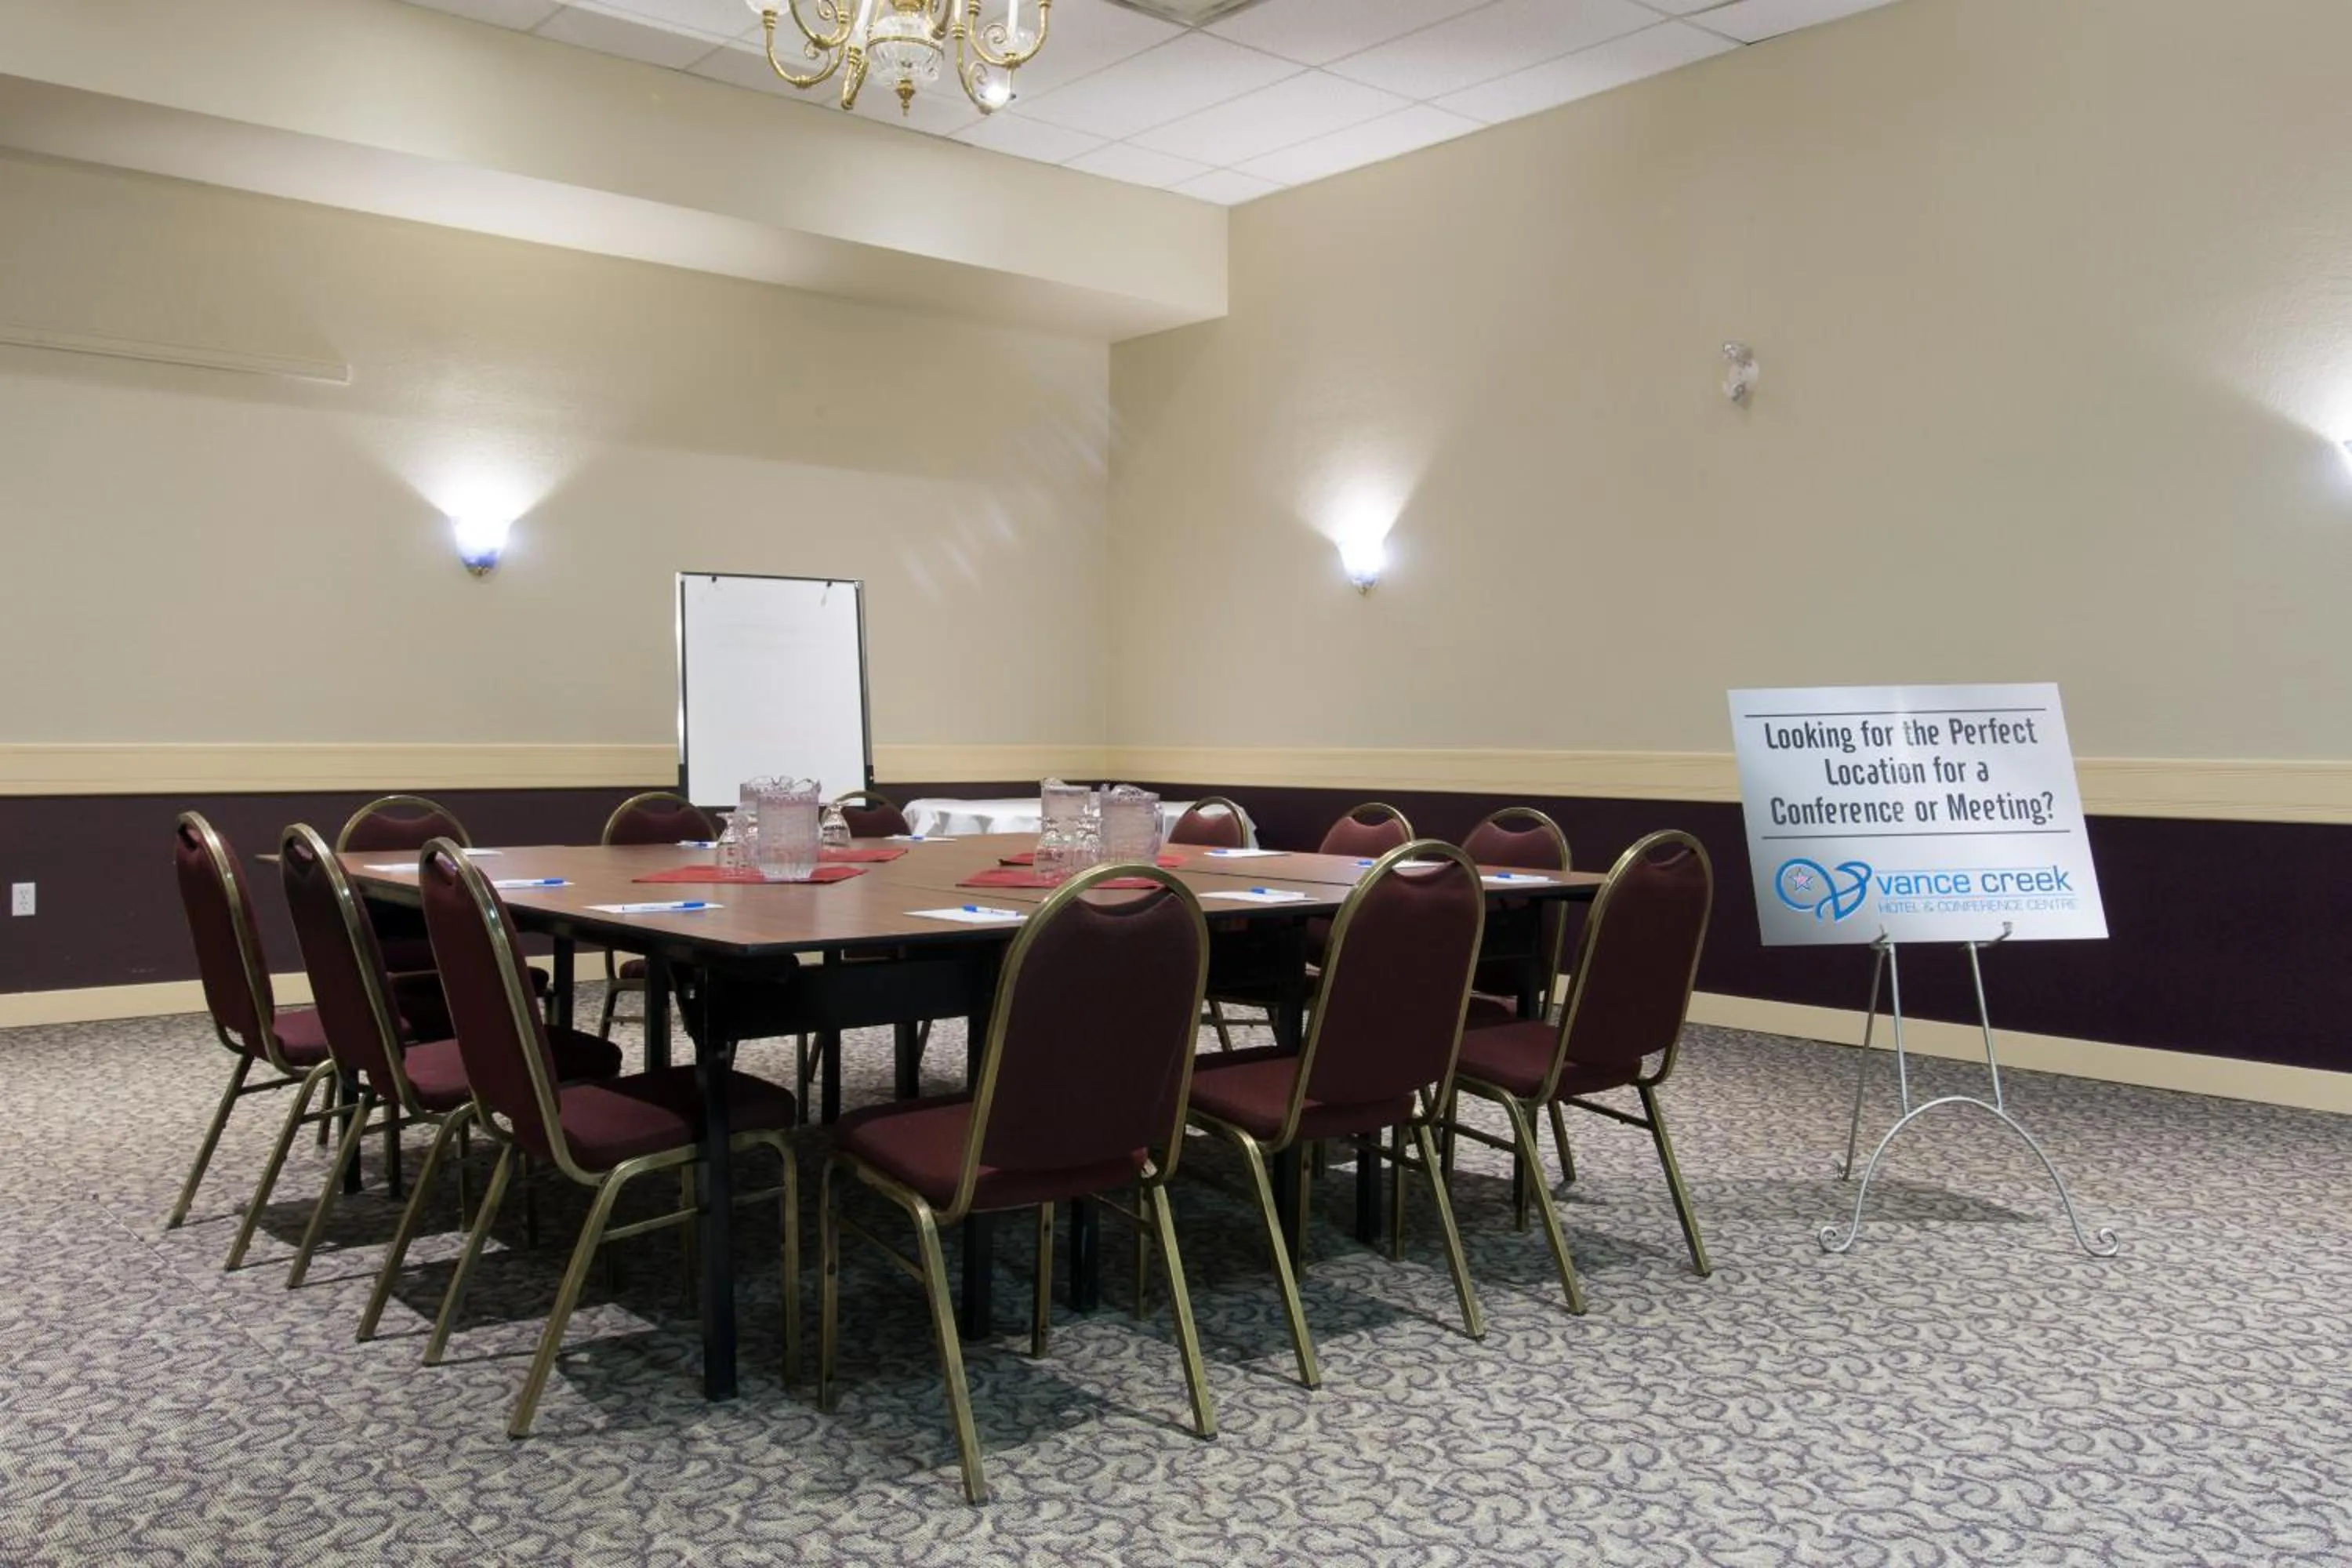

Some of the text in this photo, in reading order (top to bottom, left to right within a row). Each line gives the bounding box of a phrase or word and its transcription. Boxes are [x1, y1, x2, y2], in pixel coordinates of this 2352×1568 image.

[1764, 717, 2038, 753] Looking for the Perfect
[1824, 756, 1989, 786] Location for a
[1770, 791, 2054, 826] Conference or Meeting?
[1876, 865, 2074, 895] vance creek
[1878, 901, 1918, 914] HOTEL
